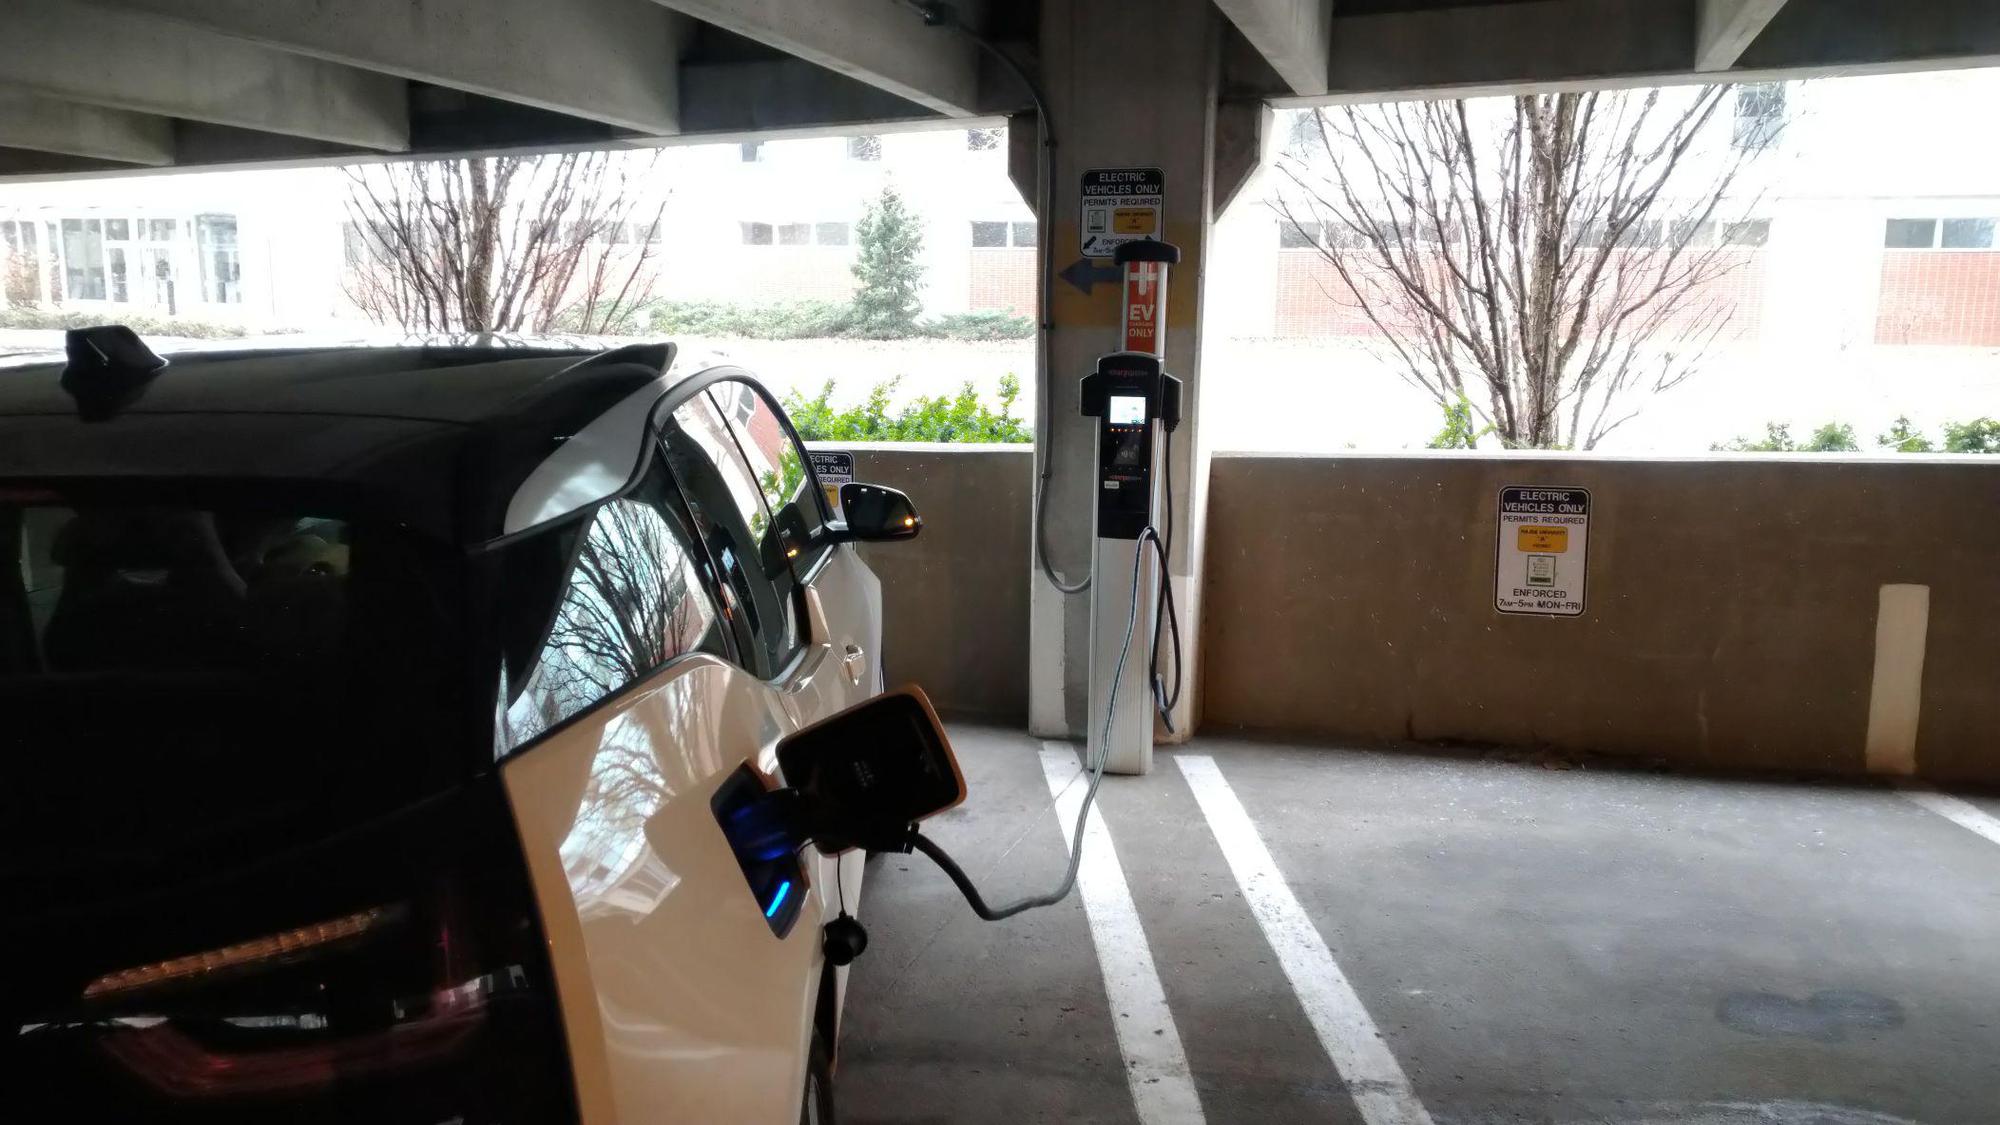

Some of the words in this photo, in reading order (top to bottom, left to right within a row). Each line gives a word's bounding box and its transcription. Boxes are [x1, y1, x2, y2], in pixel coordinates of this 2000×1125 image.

[1100, 172, 1146, 182] ELECTRIC
[1085, 185, 1131, 195] VEHICLES
[1135, 184, 1160, 194] ONLY
[1084, 198, 1117, 206] PERMITS
[1120, 197, 1161, 205] REQUIRED
[1129, 304, 1155, 321] EV
[1129, 328, 1153, 337] ONLY
[810, 455, 838, 464] ECTRIC
[829, 465, 850, 473] ONLY
[1520, 491, 1570, 501] ELECTRIC
[1504, 502, 1554, 512] VEHICLES
[1558, 503, 1585, 513] ONLY
[1503, 515, 1538, 523] PERMITS
[1541, 516, 1585, 524] REQUIRED
[1513, 588, 1567, 598] ENFORCED
[1499, 598, 1534, 608] 7AM-5PM
[1537, 600, 1581, 610] MON-FRI
